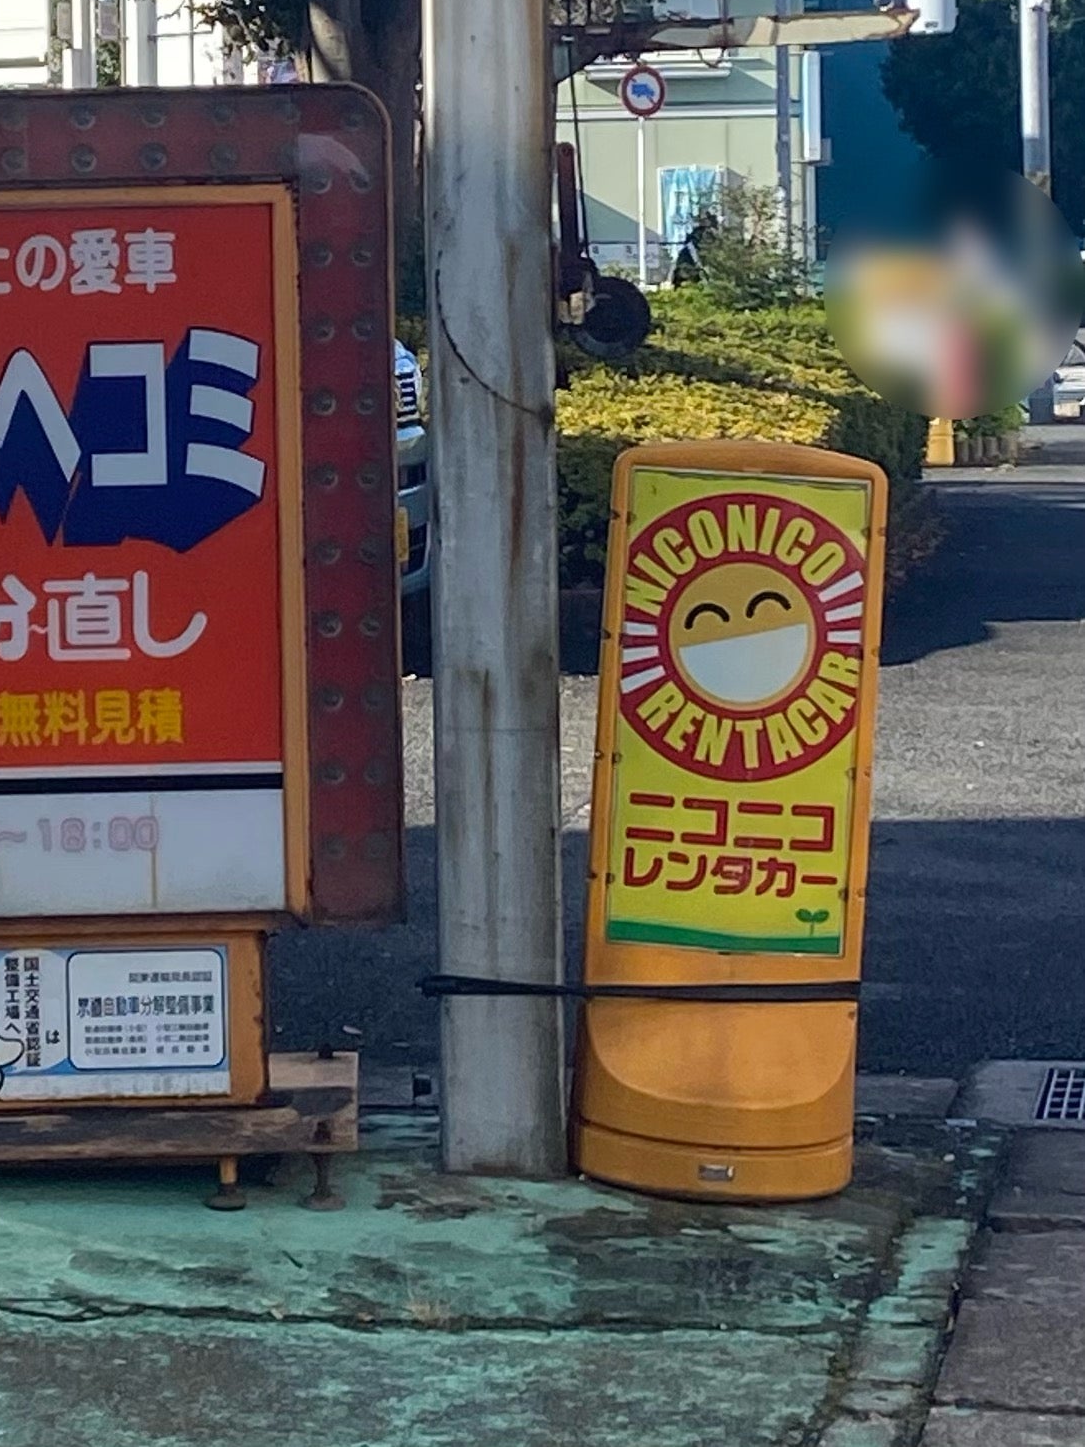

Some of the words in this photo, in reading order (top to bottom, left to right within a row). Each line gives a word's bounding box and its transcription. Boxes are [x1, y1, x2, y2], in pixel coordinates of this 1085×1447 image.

[625, 503, 846, 616] NICONICO
[635, 649, 862, 771] RENTACAR
[625, 792, 836, 853] ニコニコ
[623, 847, 839, 898] レンタカー
